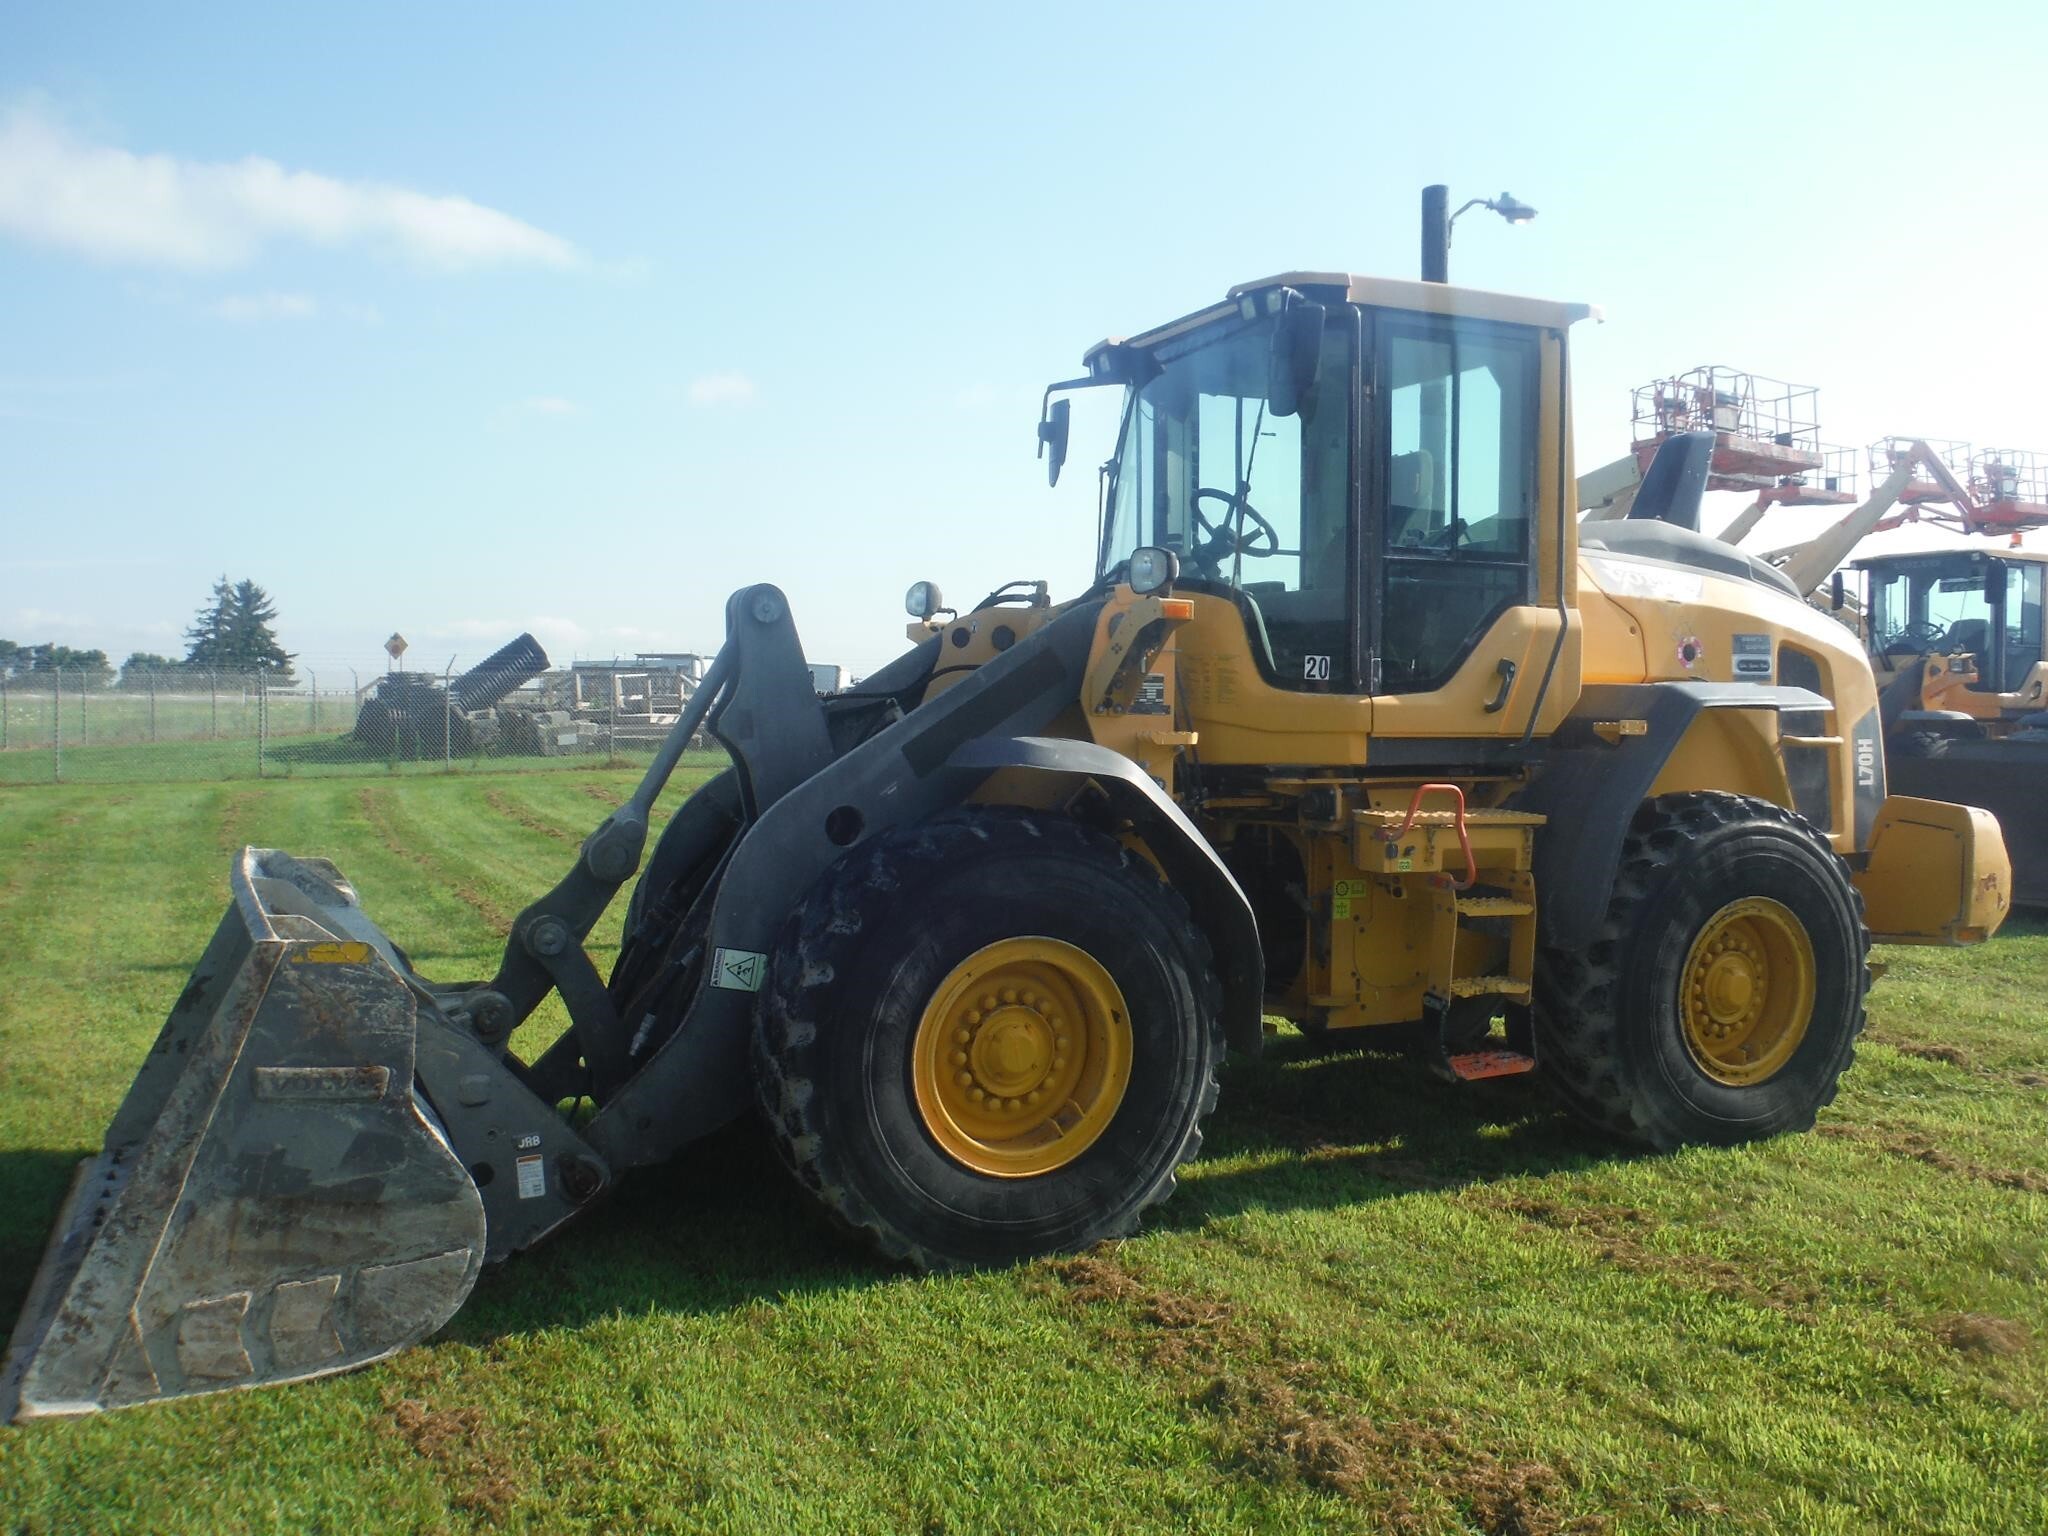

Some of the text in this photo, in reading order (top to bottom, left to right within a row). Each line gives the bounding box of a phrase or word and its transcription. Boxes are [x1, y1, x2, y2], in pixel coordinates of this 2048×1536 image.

[1306, 657, 1329, 679] 20
[1858, 738, 1873, 786] L70H
[517, 1135, 541, 1149] JRB
